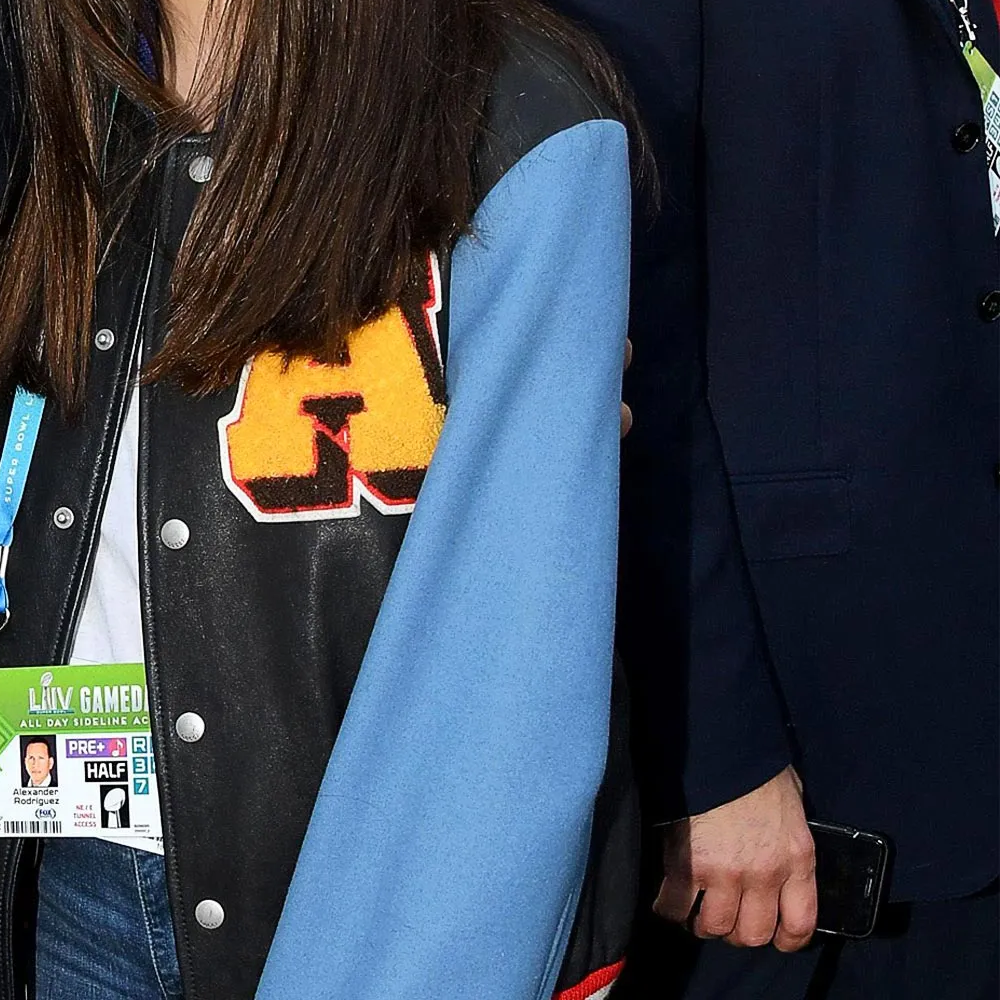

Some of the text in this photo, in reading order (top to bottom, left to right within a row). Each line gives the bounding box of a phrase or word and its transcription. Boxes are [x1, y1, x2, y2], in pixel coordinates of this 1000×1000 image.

[5, 458, 18, 503] SUPER
[15, 414, 30, 451] BOWL
[20, 718, 42, 728] ALL
[47, 717, 69, 728] DAY
[74, 716, 127, 727] SIDELINE
[133, 738, 147, 753] R
[86, 762, 126, 779] HALF
[12, 787, 60, 797] Alexander
[135, 779, 147, 794] 7
[13, 796, 60, 807] Rodriguez
[73, 820, 97, 829] ACCESS
